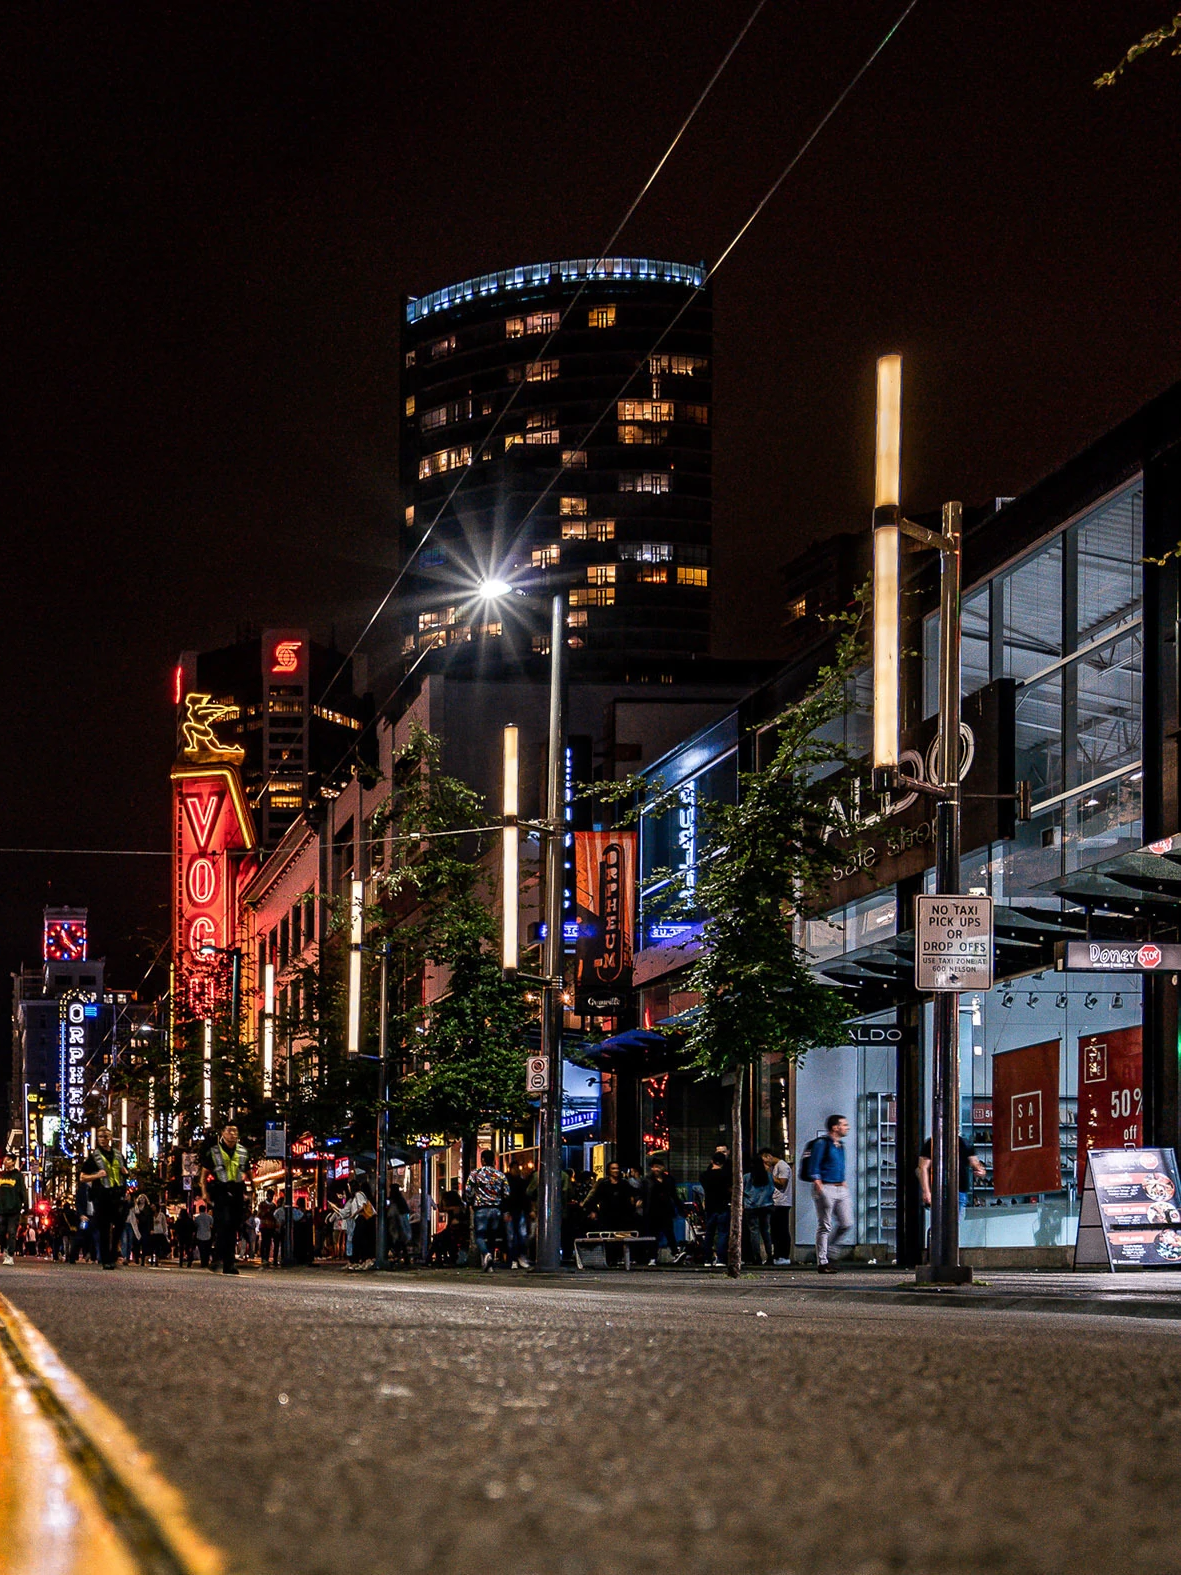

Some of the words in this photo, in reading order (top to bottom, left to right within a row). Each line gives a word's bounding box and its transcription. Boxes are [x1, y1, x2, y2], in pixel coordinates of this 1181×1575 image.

[832, 846, 876, 881] sale
[605, 850, 619, 968] ORPHEUM
[932, 905, 948, 915] NO
[954, 905, 978, 915] TAXI
[929, 917, 954, 926] PICK
[960, 917, 981, 927] UPS
[947, 929, 963, 939] OR
[923, 941, 953, 951] DROP
[959, 942, 986, 952] OFFS
[1089, 944, 1138, 963] Doner
[1140, 950, 1159, 963] STOP
[69, 1003, 85, 1144] ORPHEU
[1111, 1088, 1143, 1119] 50%
[1123, 1125, 1137, 1140] off
